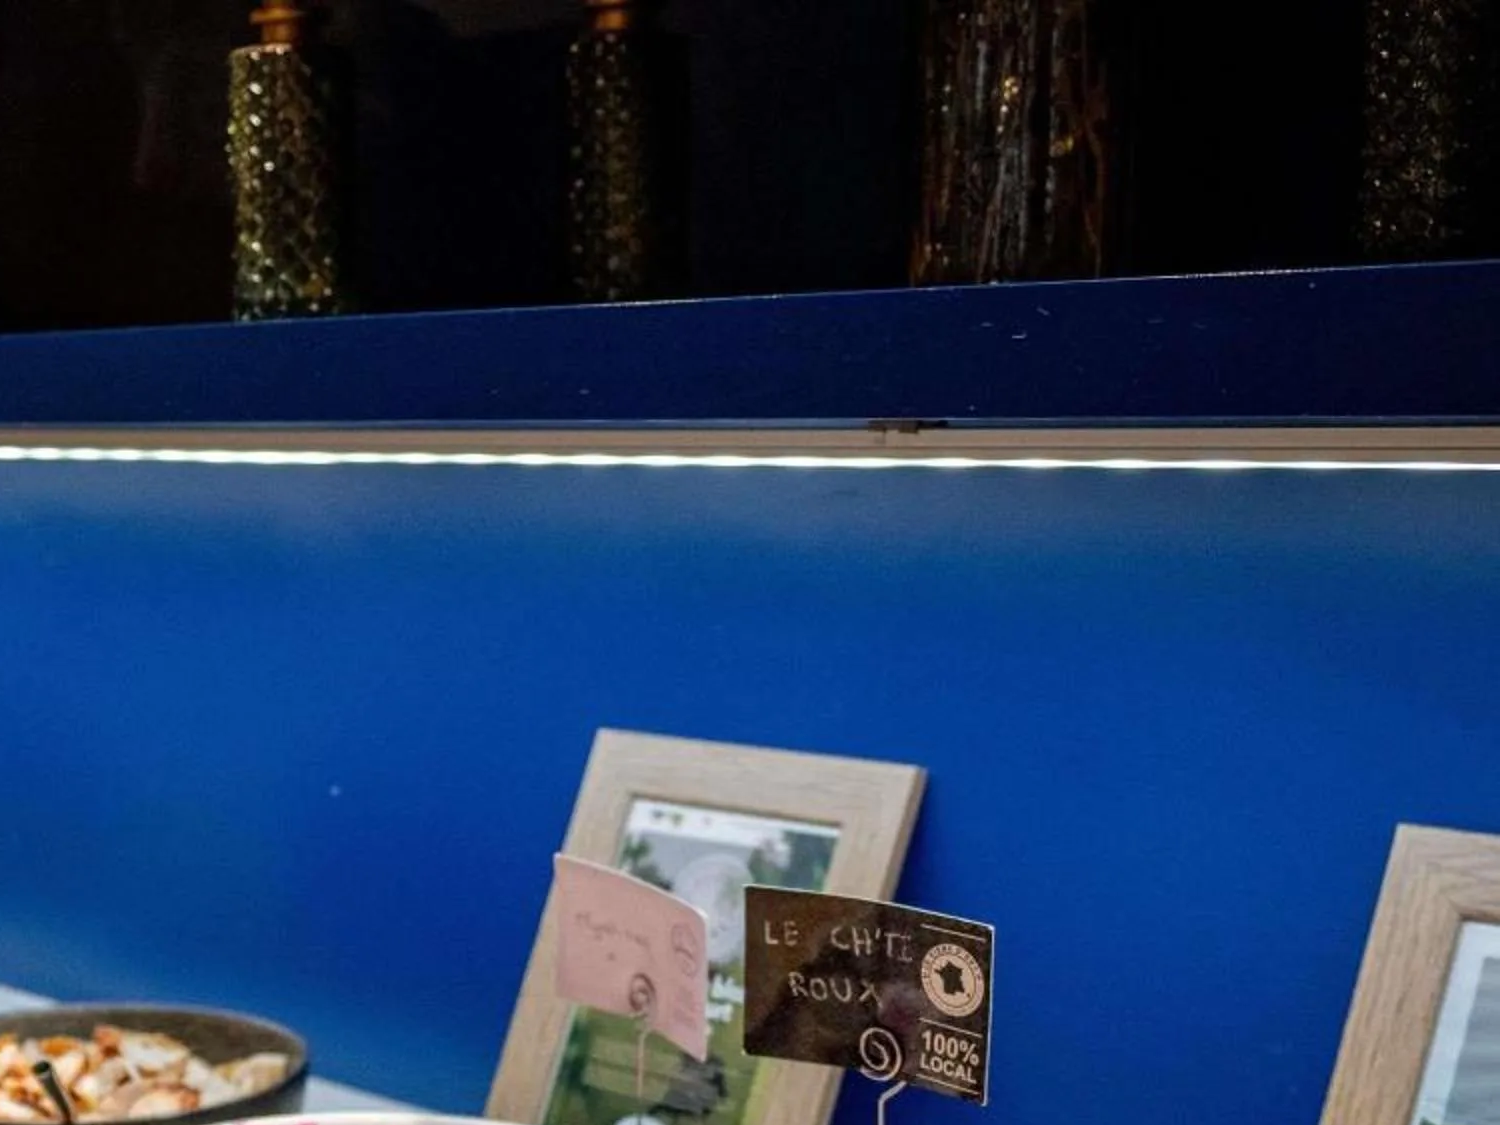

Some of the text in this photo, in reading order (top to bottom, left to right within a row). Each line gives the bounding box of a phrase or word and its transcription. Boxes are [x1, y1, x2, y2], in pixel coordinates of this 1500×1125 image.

[764, 920, 913, 962] LE CH'TI
[788, 971, 884, 1009] ROUX
[921, 1029, 980, 1066] 100%
[919, 1052, 977, 1084] LOCAL
